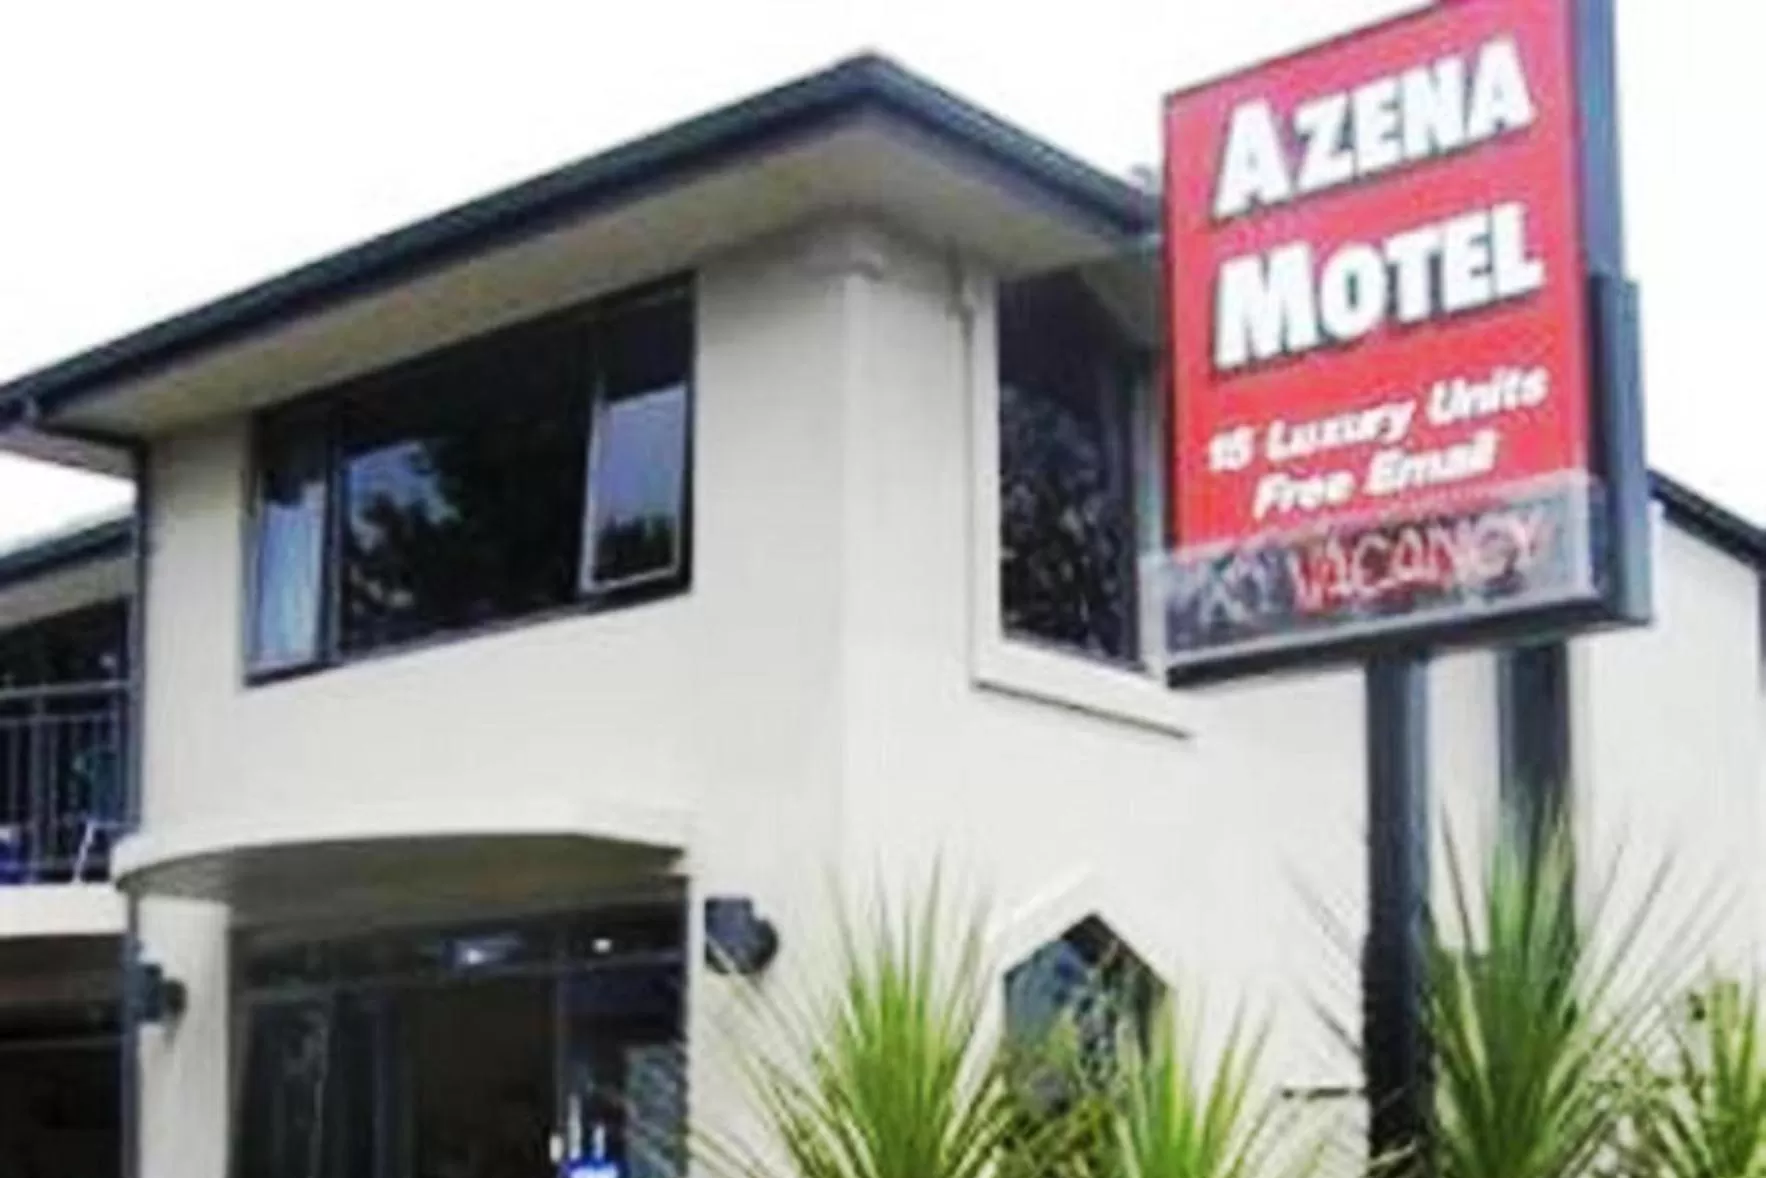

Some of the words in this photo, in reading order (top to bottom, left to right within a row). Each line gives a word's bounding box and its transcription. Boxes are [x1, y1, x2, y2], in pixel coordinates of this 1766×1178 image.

[1214, 38, 1532, 218] AZENA
[1215, 203, 1544, 368] MOTEL
[1255, 473, 1354, 519] Free
[1368, 433, 1497, 494] Email
[1266, 400, 1415, 460] Luxury
[1429, 368, 1548, 425] Units
